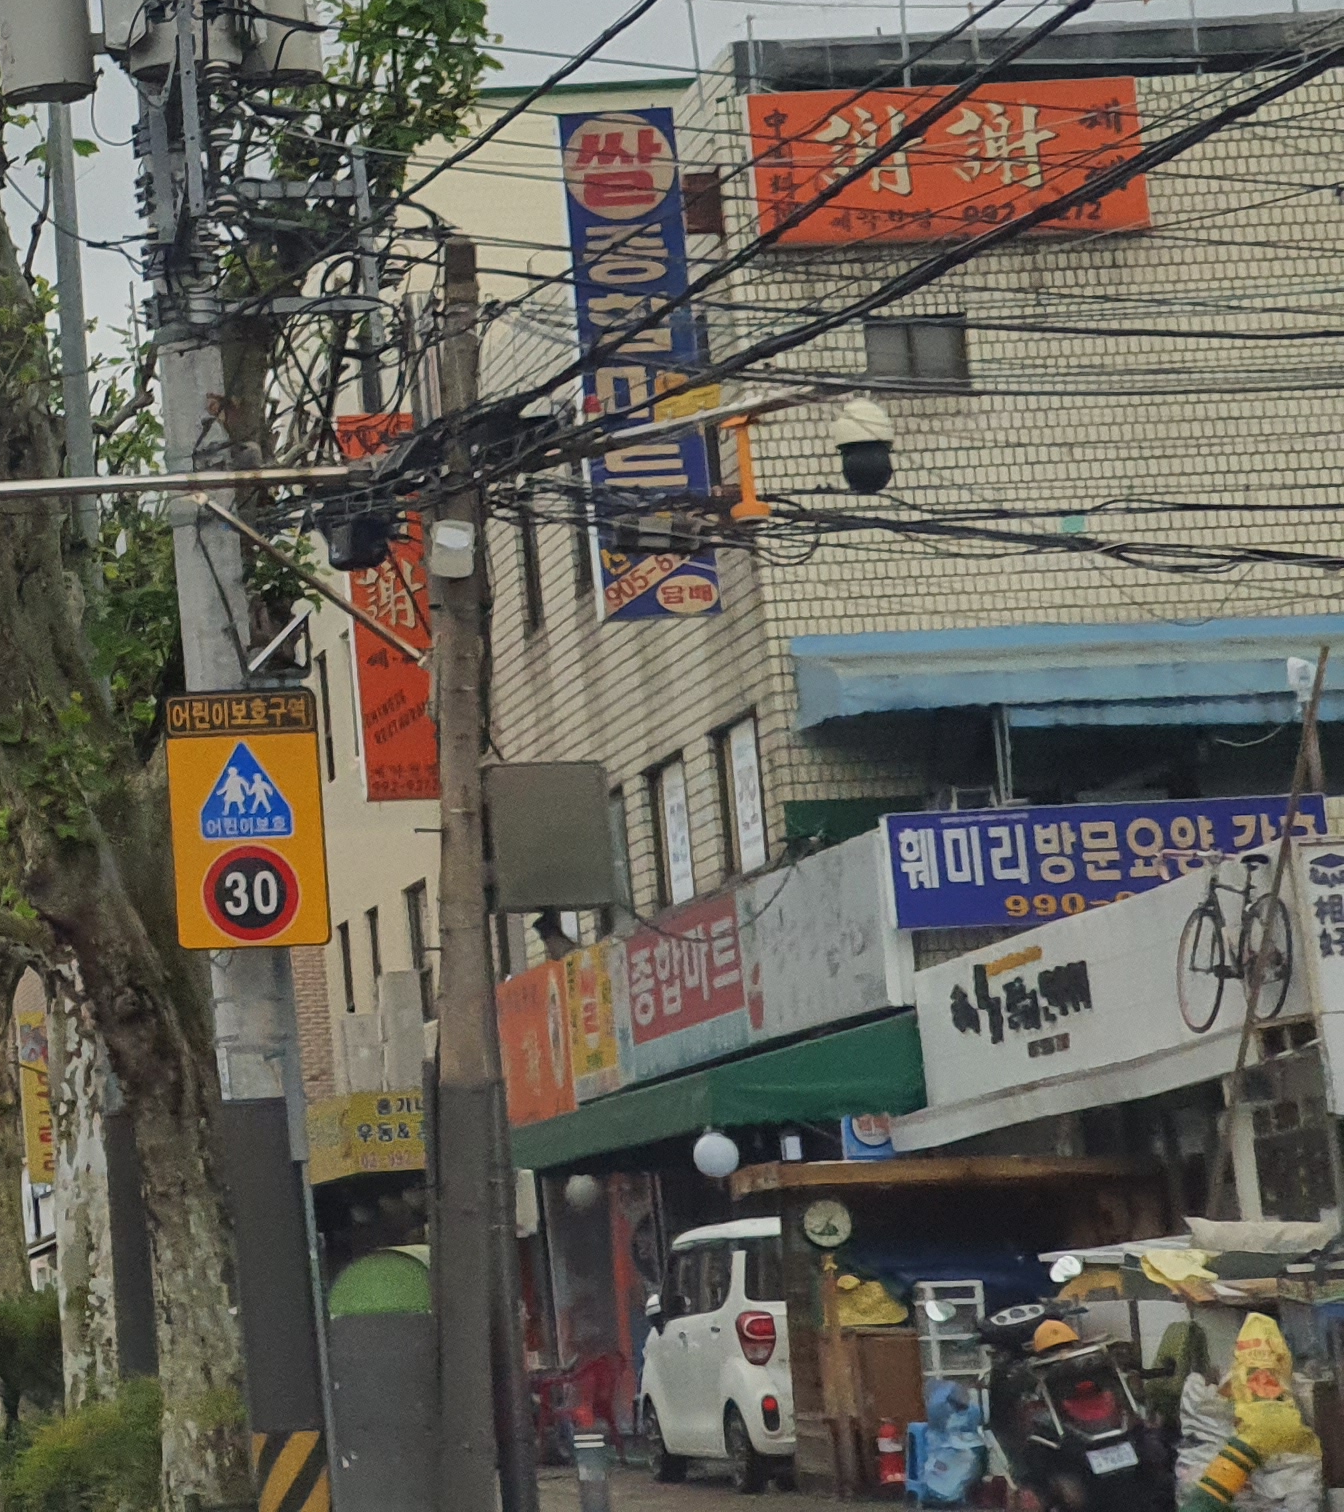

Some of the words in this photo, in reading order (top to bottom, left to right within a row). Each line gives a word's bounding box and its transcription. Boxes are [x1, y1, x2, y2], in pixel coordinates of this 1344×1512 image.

[576, 129, 662, 207] 쌀
[172, 697, 306, 731] 어린이보호구역
[206, 816, 288, 835] 어린이보호
[224, 870, 279, 917] 30
[630, 915, 741, 1026] 종합마트
